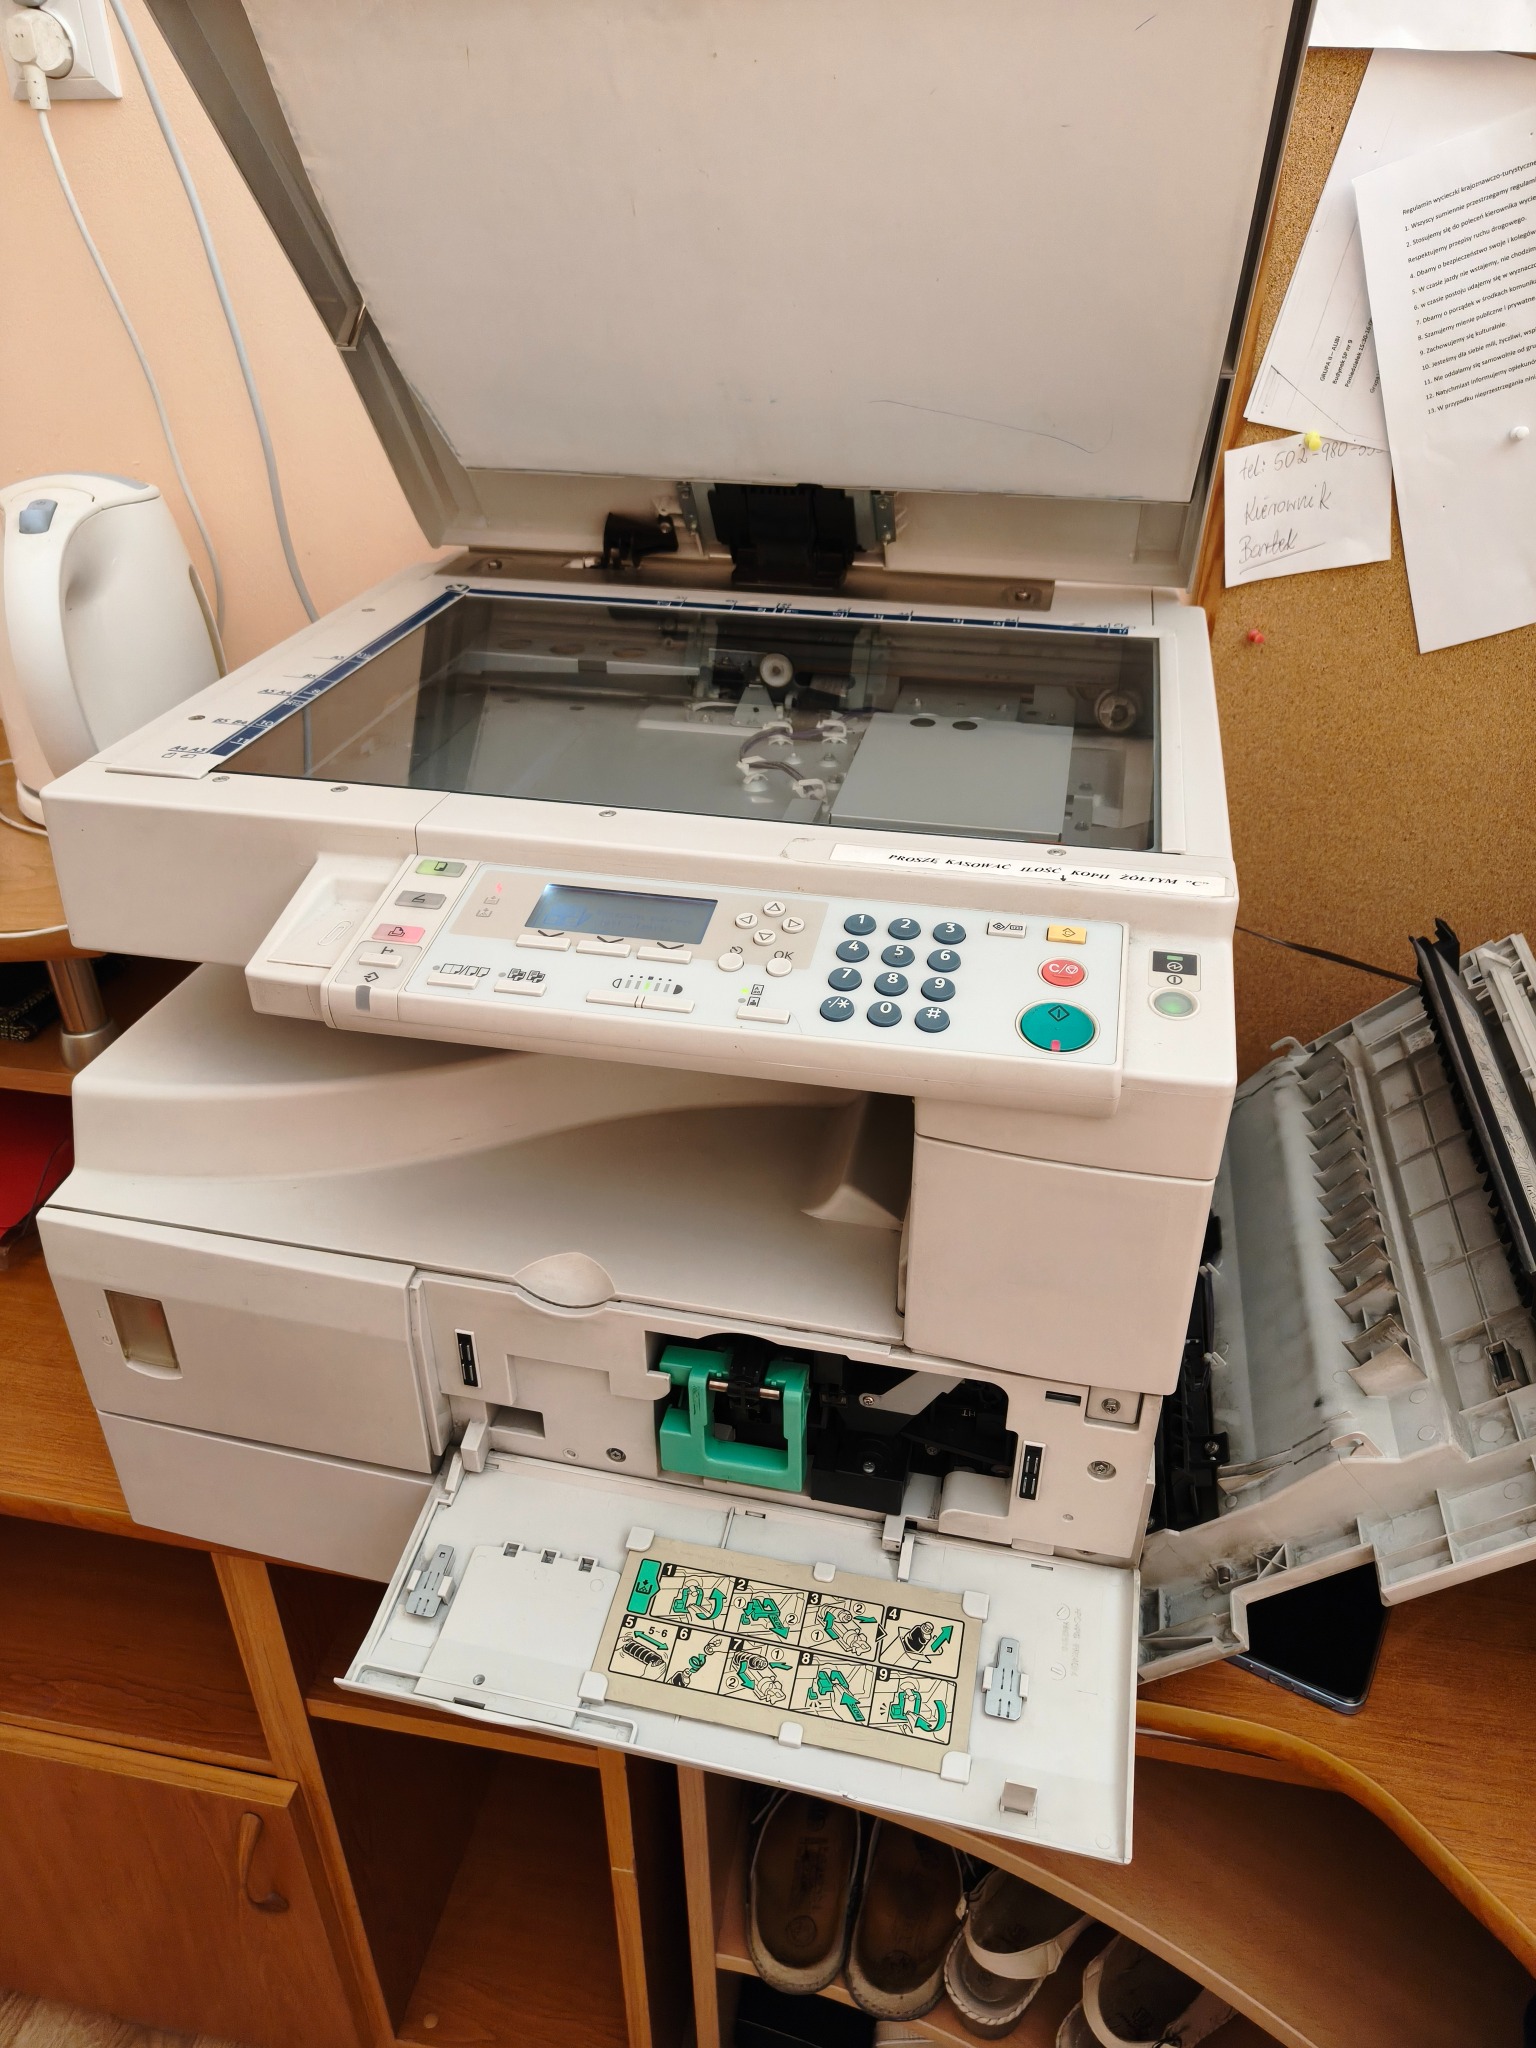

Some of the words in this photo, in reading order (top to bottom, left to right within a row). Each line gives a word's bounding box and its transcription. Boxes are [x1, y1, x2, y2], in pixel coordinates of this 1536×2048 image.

[1402, 199, 1433, 216] Regulamin
[1432, 187, 1460, 204] wycieczki
[1410, 216, 1435, 229] Wszyscy
[1435, 204, 1465, 220] sumiennie
[1465, 187, 1509, 209] przestrzegamy
[1412, 230, 1442, 246] Stosujemy
[1443, 226, 1451, 234] się
[1461, 213, 1484, 228] poleceń
[1484, 201, 1518, 218] kierownika
[1407, 243, 1448, 263] Respektujemy
[1448, 235, 1473, 249] przepisy
[1473, 229, 1490, 239] ruchu
[1491, 216, 1527, 233] drogowego.
[1416, 265, 1437, 277] Dbamy
[1442, 246, 1488, 268] bezpieczeństwo
[1488, 240, 1506, 251] swoje
[1418, 285, 1426, 293] W
[1426, 280, 1443, 290] czasie
[1443, 274, 1459, 285] jazdy
[1469, 260, 1500, 274] wstajemy,
[1500, 255, 1510, 263] nie
[1426, 295, 1444, 306] czasie
[1444, 287, 1466, 300] postoju
[1467, 278, 1492, 292] udajemy
[1492, 274, 1501, 282] się
[1422, 313, 1443, 323] Dbamy
[1448, 301, 1475, 315] porządek
[1481, 289, 1508, 303] środkach
[1424, 324, 1454, 339] Szanujemy
[1455, 318, 1475, 328] mienie
[1475, 307, 1503, 321] publiczne
[1426, 336, 1465, 354] Zachowujemy
[1467, 345, 1484, 355] siebie
[1332, 359, 1345, 385] Budynek
[1444, 365, 1472, 380] oddalamy
[1481, 351, 1516, 366] samowolnie
[1435, 381, 1470, 396] Natychmiast
[1471, 367, 1507, 385] informujemy
[1444, 395, 1474, 410] przypadku
[1474, 379, 1524, 399] nieprzestrzegania
[1239, 455, 1266, 481] tel:
[1244, 481, 1332, 526] Kierownik
[888, 853, 941, 865] PROSZĘ
[945, 858, 1012, 870] KASOWAĆ
[1020, 866, 1063, 874] ILOŚĆ
[1070, 869, 1110, 880] KOPII
[1119, 873, 1178, 885] ŻÓŁTYM
[858, 914, 866, 924] 1
[900, 918, 912, 929] 2
[945, 922, 956, 933] 3
[773, 950, 794, 960] OK
[848, 940, 860, 951] 4
[894, 945, 905, 956] 5
[940, 949, 951, 961] 6
[841, 968, 853, 979] 7
[886, 973, 899, 984] 8
[934, 978, 946, 989] 9
[879, 1002, 893, 1014] 0
[666, 1564, 673, 1576] 1
[735, 1579, 745, 1590] 2
[810, 1593, 819, 1604] 3
[625, 1616, 635, 1627] 5
[771, 1615, 783, 1631] SLOW
[888, 1608, 898, 1620] 4
[679, 1628, 689, 1639] 6
[733, 1638, 742, 1649] 7
[801, 1653, 812, 1665] 8
[879, 1669, 888, 1681] 9
[850, 1702, 863, 1721] SLOW
